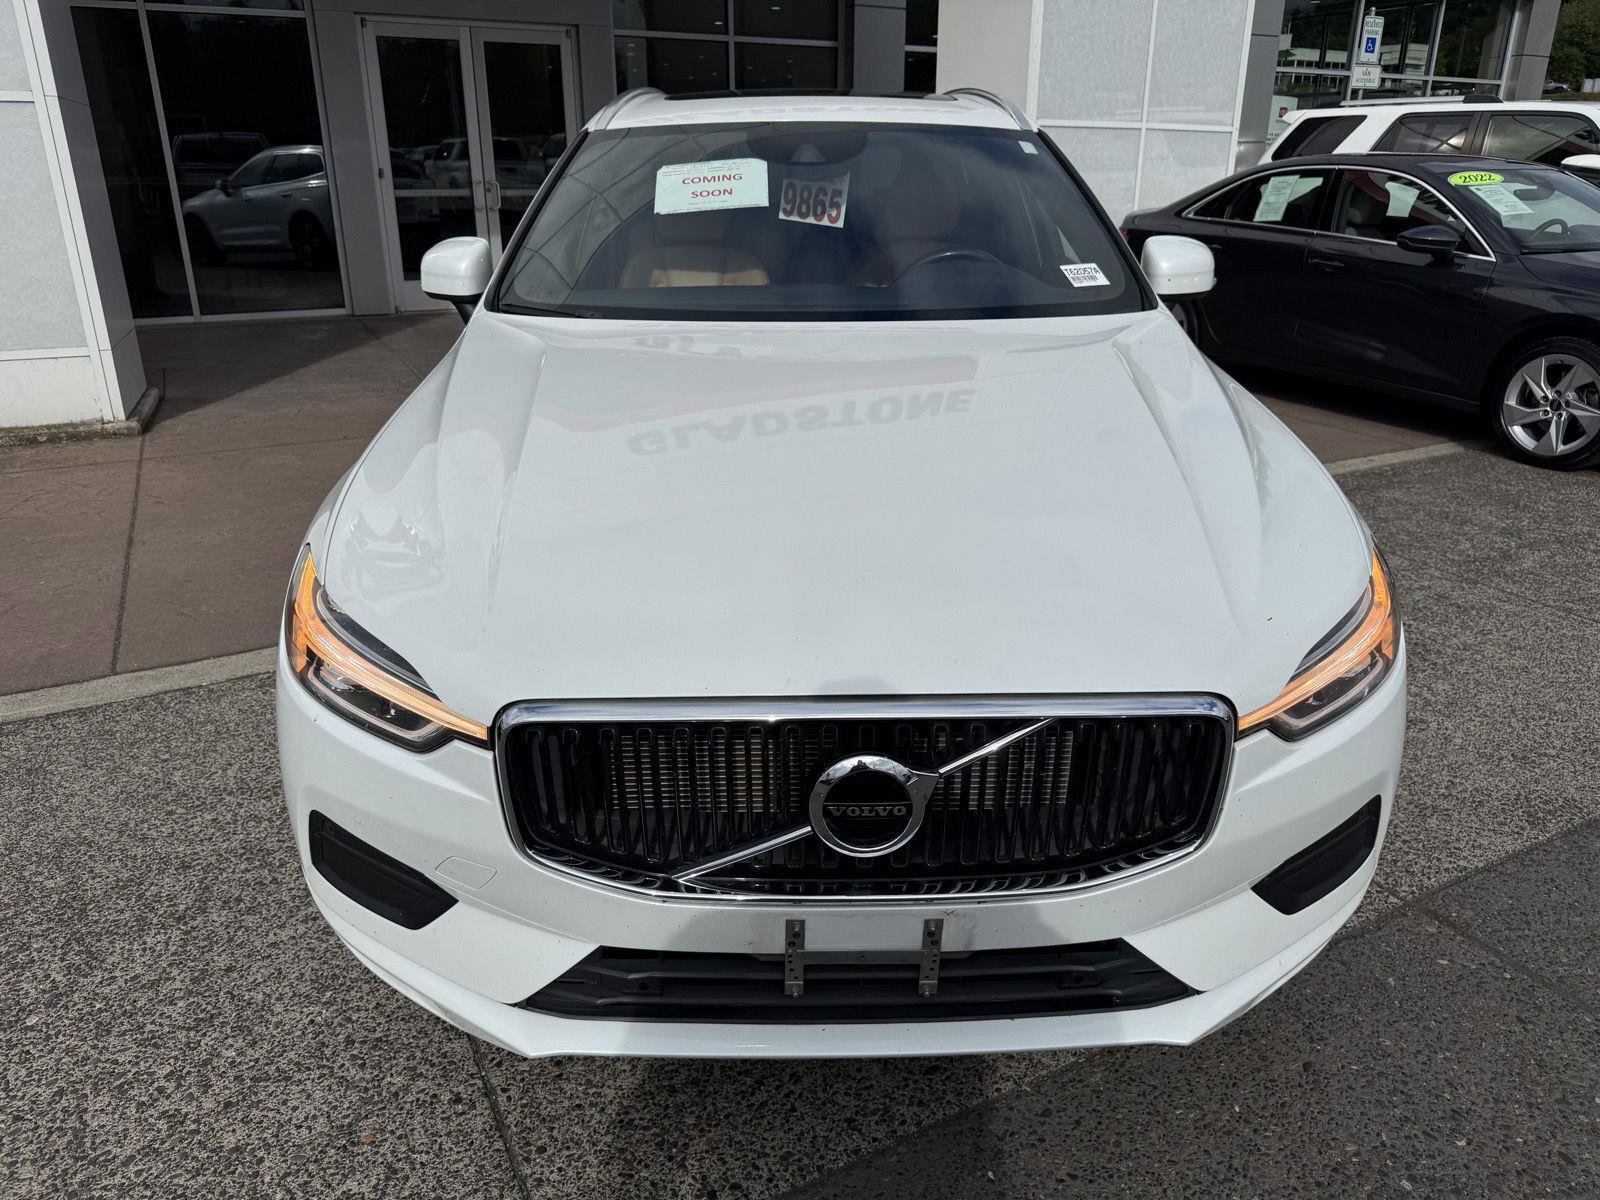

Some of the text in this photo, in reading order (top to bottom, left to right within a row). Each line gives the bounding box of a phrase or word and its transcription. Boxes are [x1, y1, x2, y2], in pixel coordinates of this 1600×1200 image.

[682, 173, 743, 185] COMING
[1459, 173, 1496, 184] 2022
[691, 188, 733, 198] SOON
[782, 182, 843, 224] 9865
[827, 806, 907, 817] VOLVO
